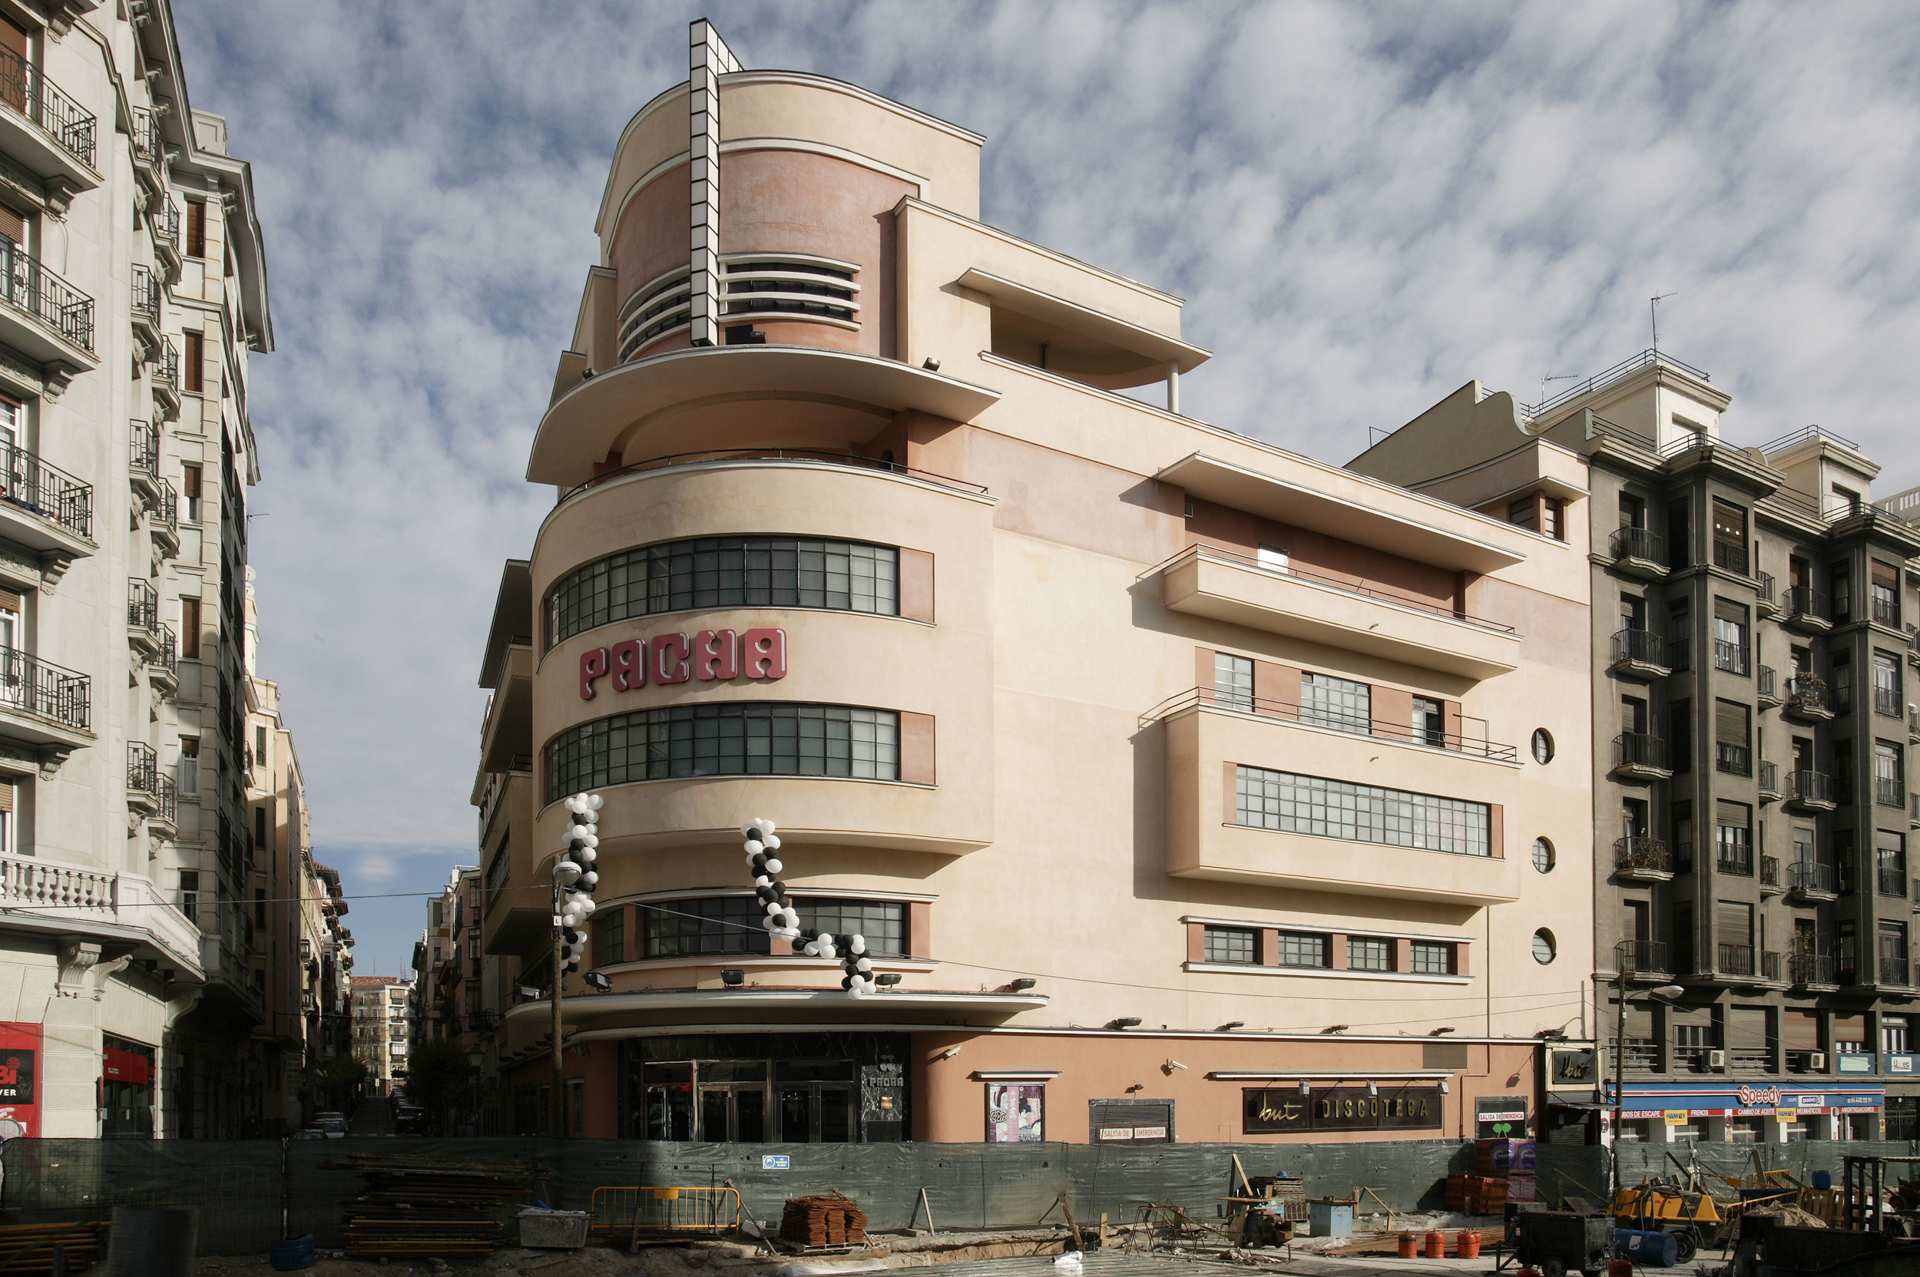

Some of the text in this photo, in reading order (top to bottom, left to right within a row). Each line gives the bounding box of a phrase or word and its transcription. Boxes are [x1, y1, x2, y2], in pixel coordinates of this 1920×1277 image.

[580, 628, 787, 700] PACHA
[1741, 1085, 1781, 1106] Speedy
[1321, 1098, 1429, 1118] DISCOTECA
